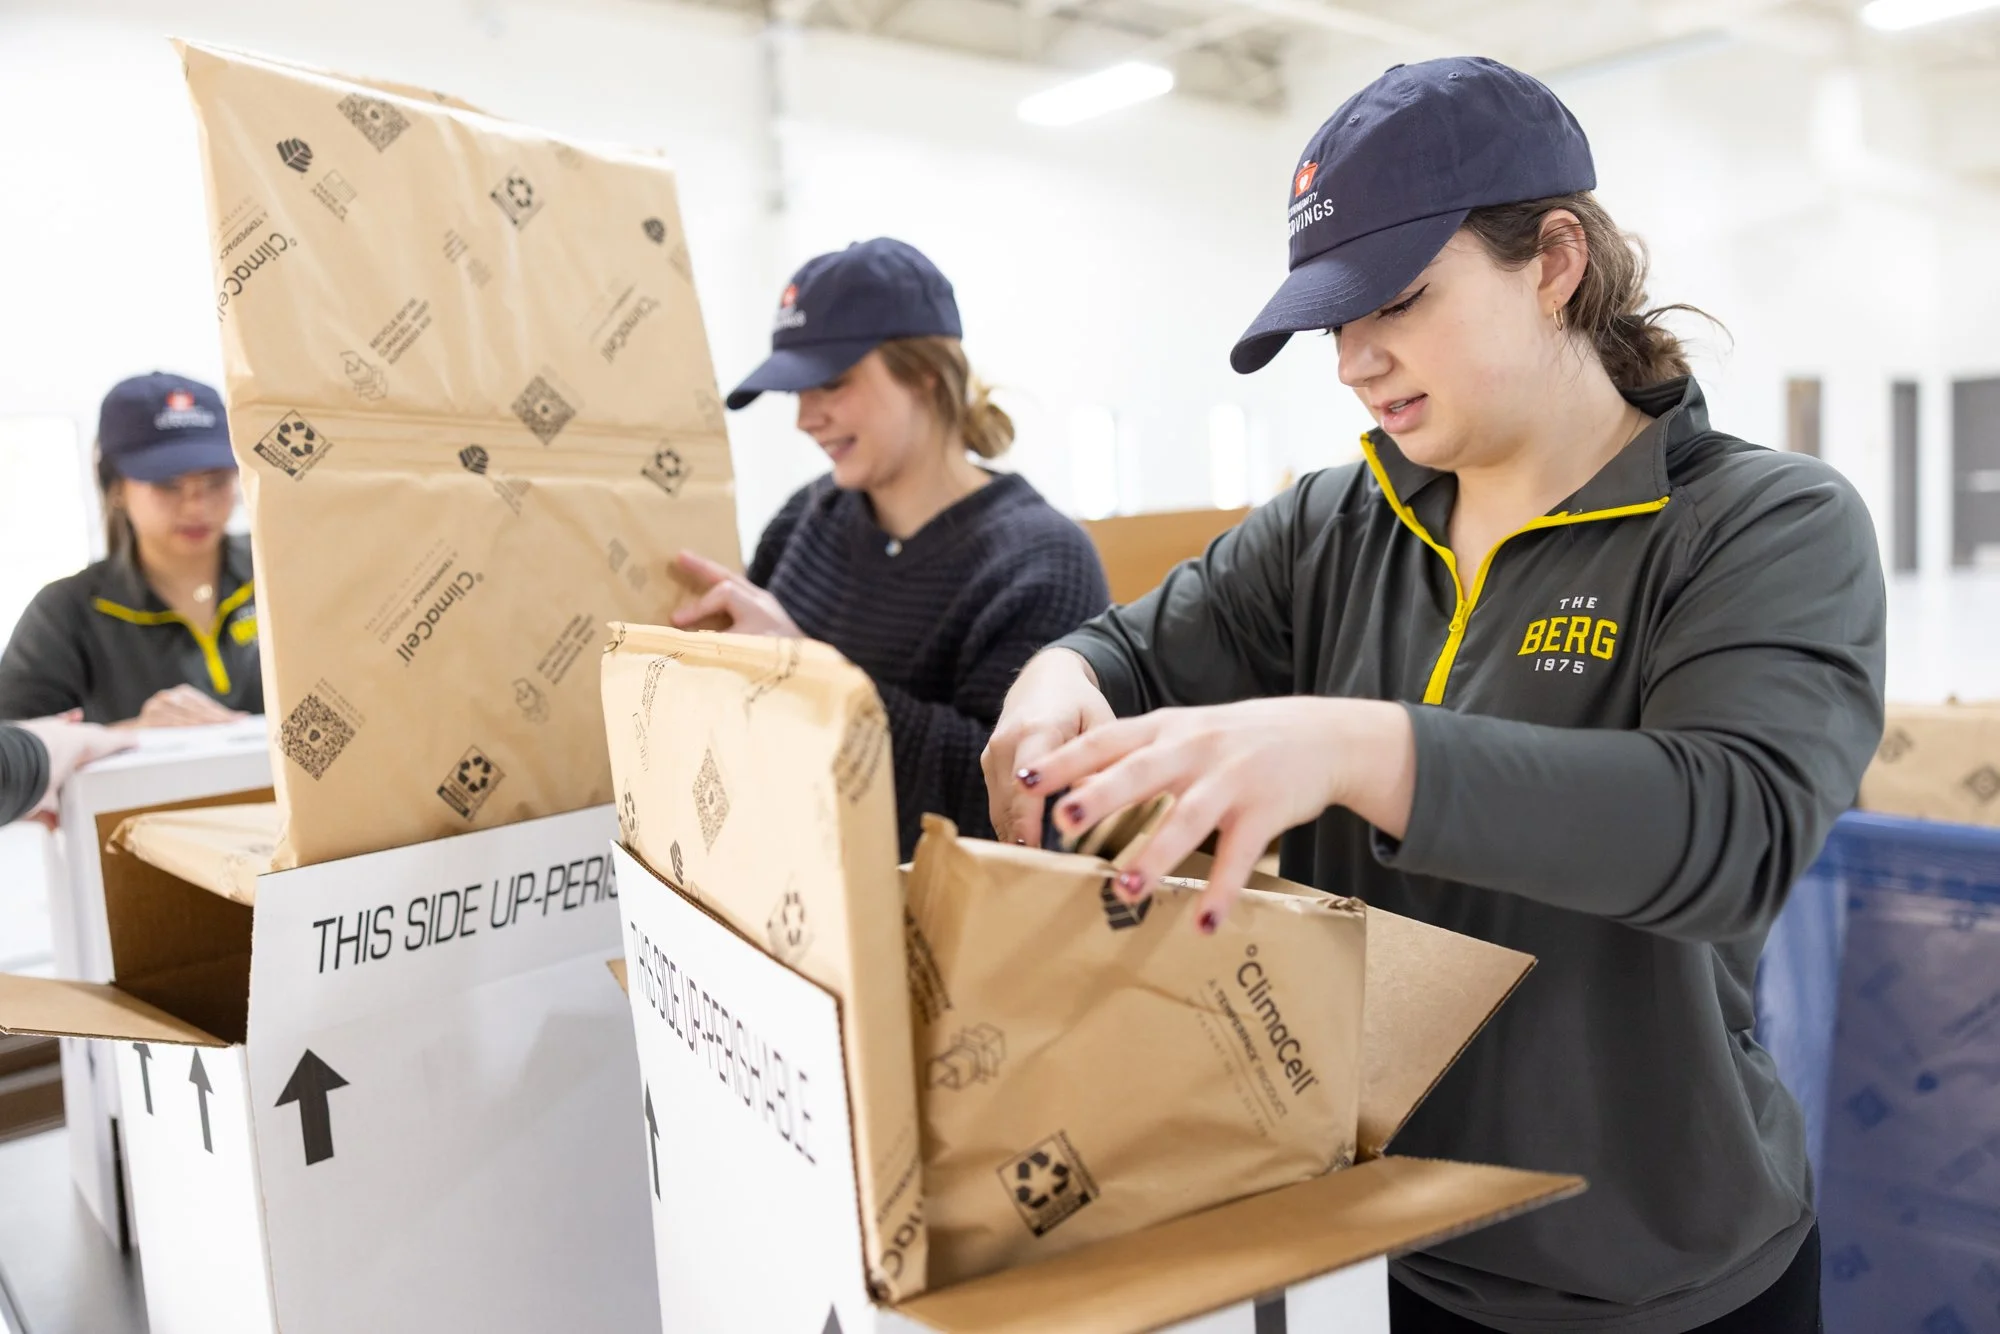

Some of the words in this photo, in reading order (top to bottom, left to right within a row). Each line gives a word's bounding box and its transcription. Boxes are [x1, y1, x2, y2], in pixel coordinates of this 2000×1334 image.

[1559, 596, 1598, 610] THE
[1517, 616, 1618, 660] BERG
[1534, 658, 1585, 674] 1975
[313, 904, 394, 974] THIS
[405, 884, 483, 951] SIDE
